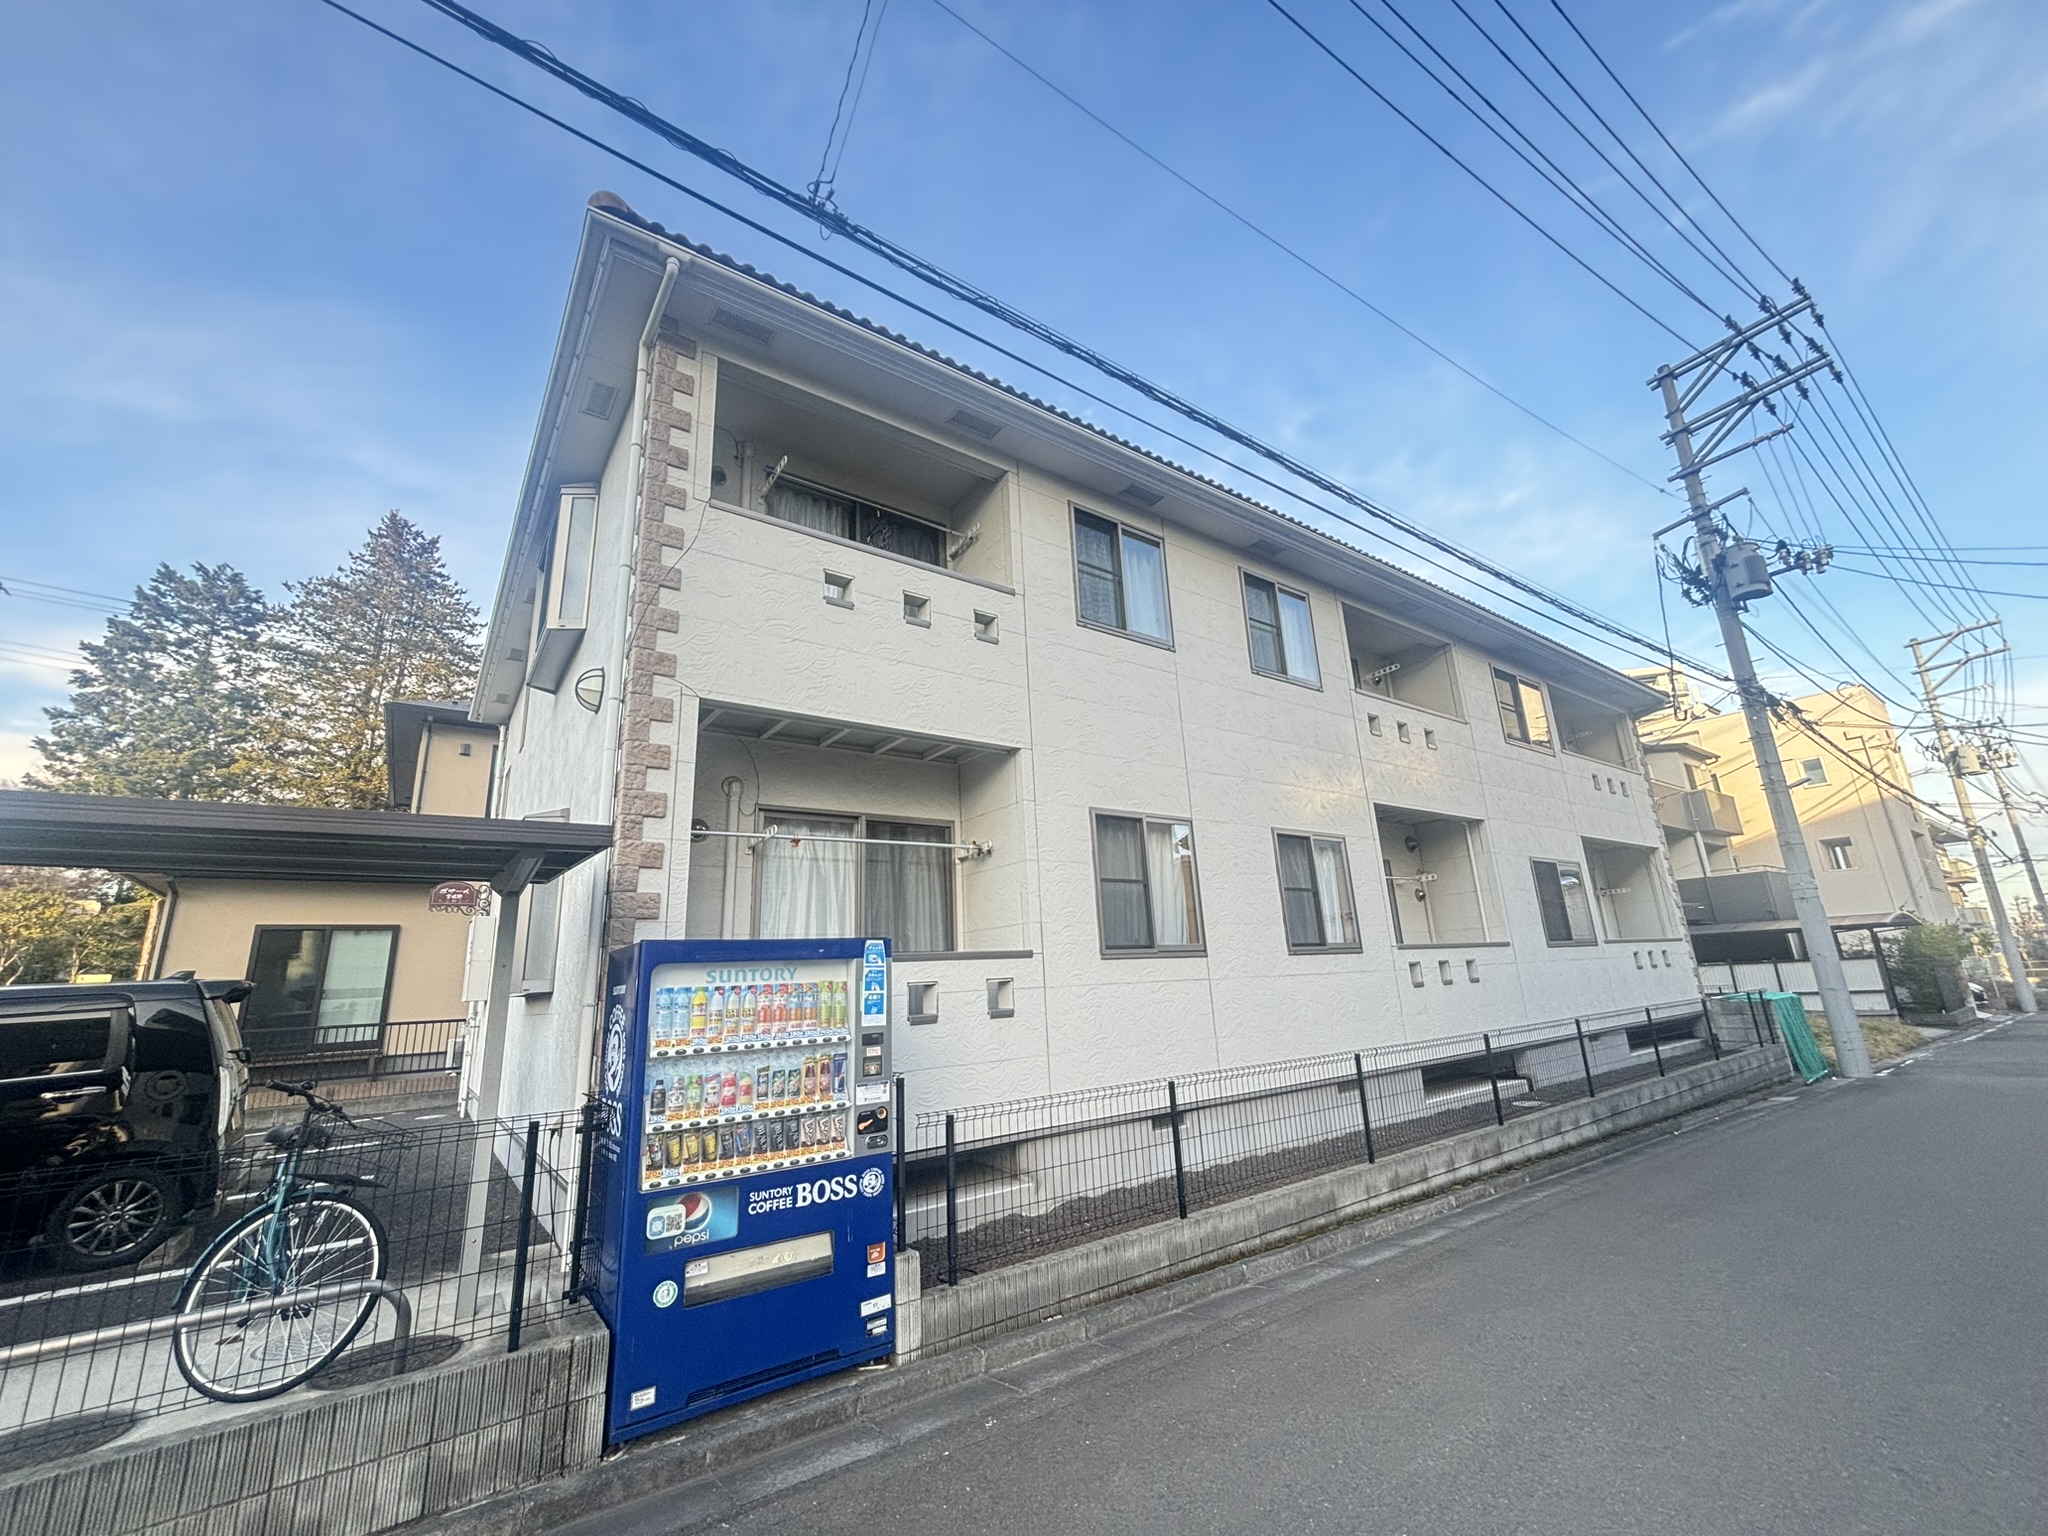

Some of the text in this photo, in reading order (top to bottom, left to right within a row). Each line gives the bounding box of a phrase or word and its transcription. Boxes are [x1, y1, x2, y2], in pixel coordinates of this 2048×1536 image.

[706, 967, 798, 983] SUNTORY
[748, 1197, 793, 1215] COFFEE
[796, 1174, 858, 1208] BOSS
[749, 1186, 793, 1202] SUNTORY
[674, 1229, 709, 1247] pepsi
